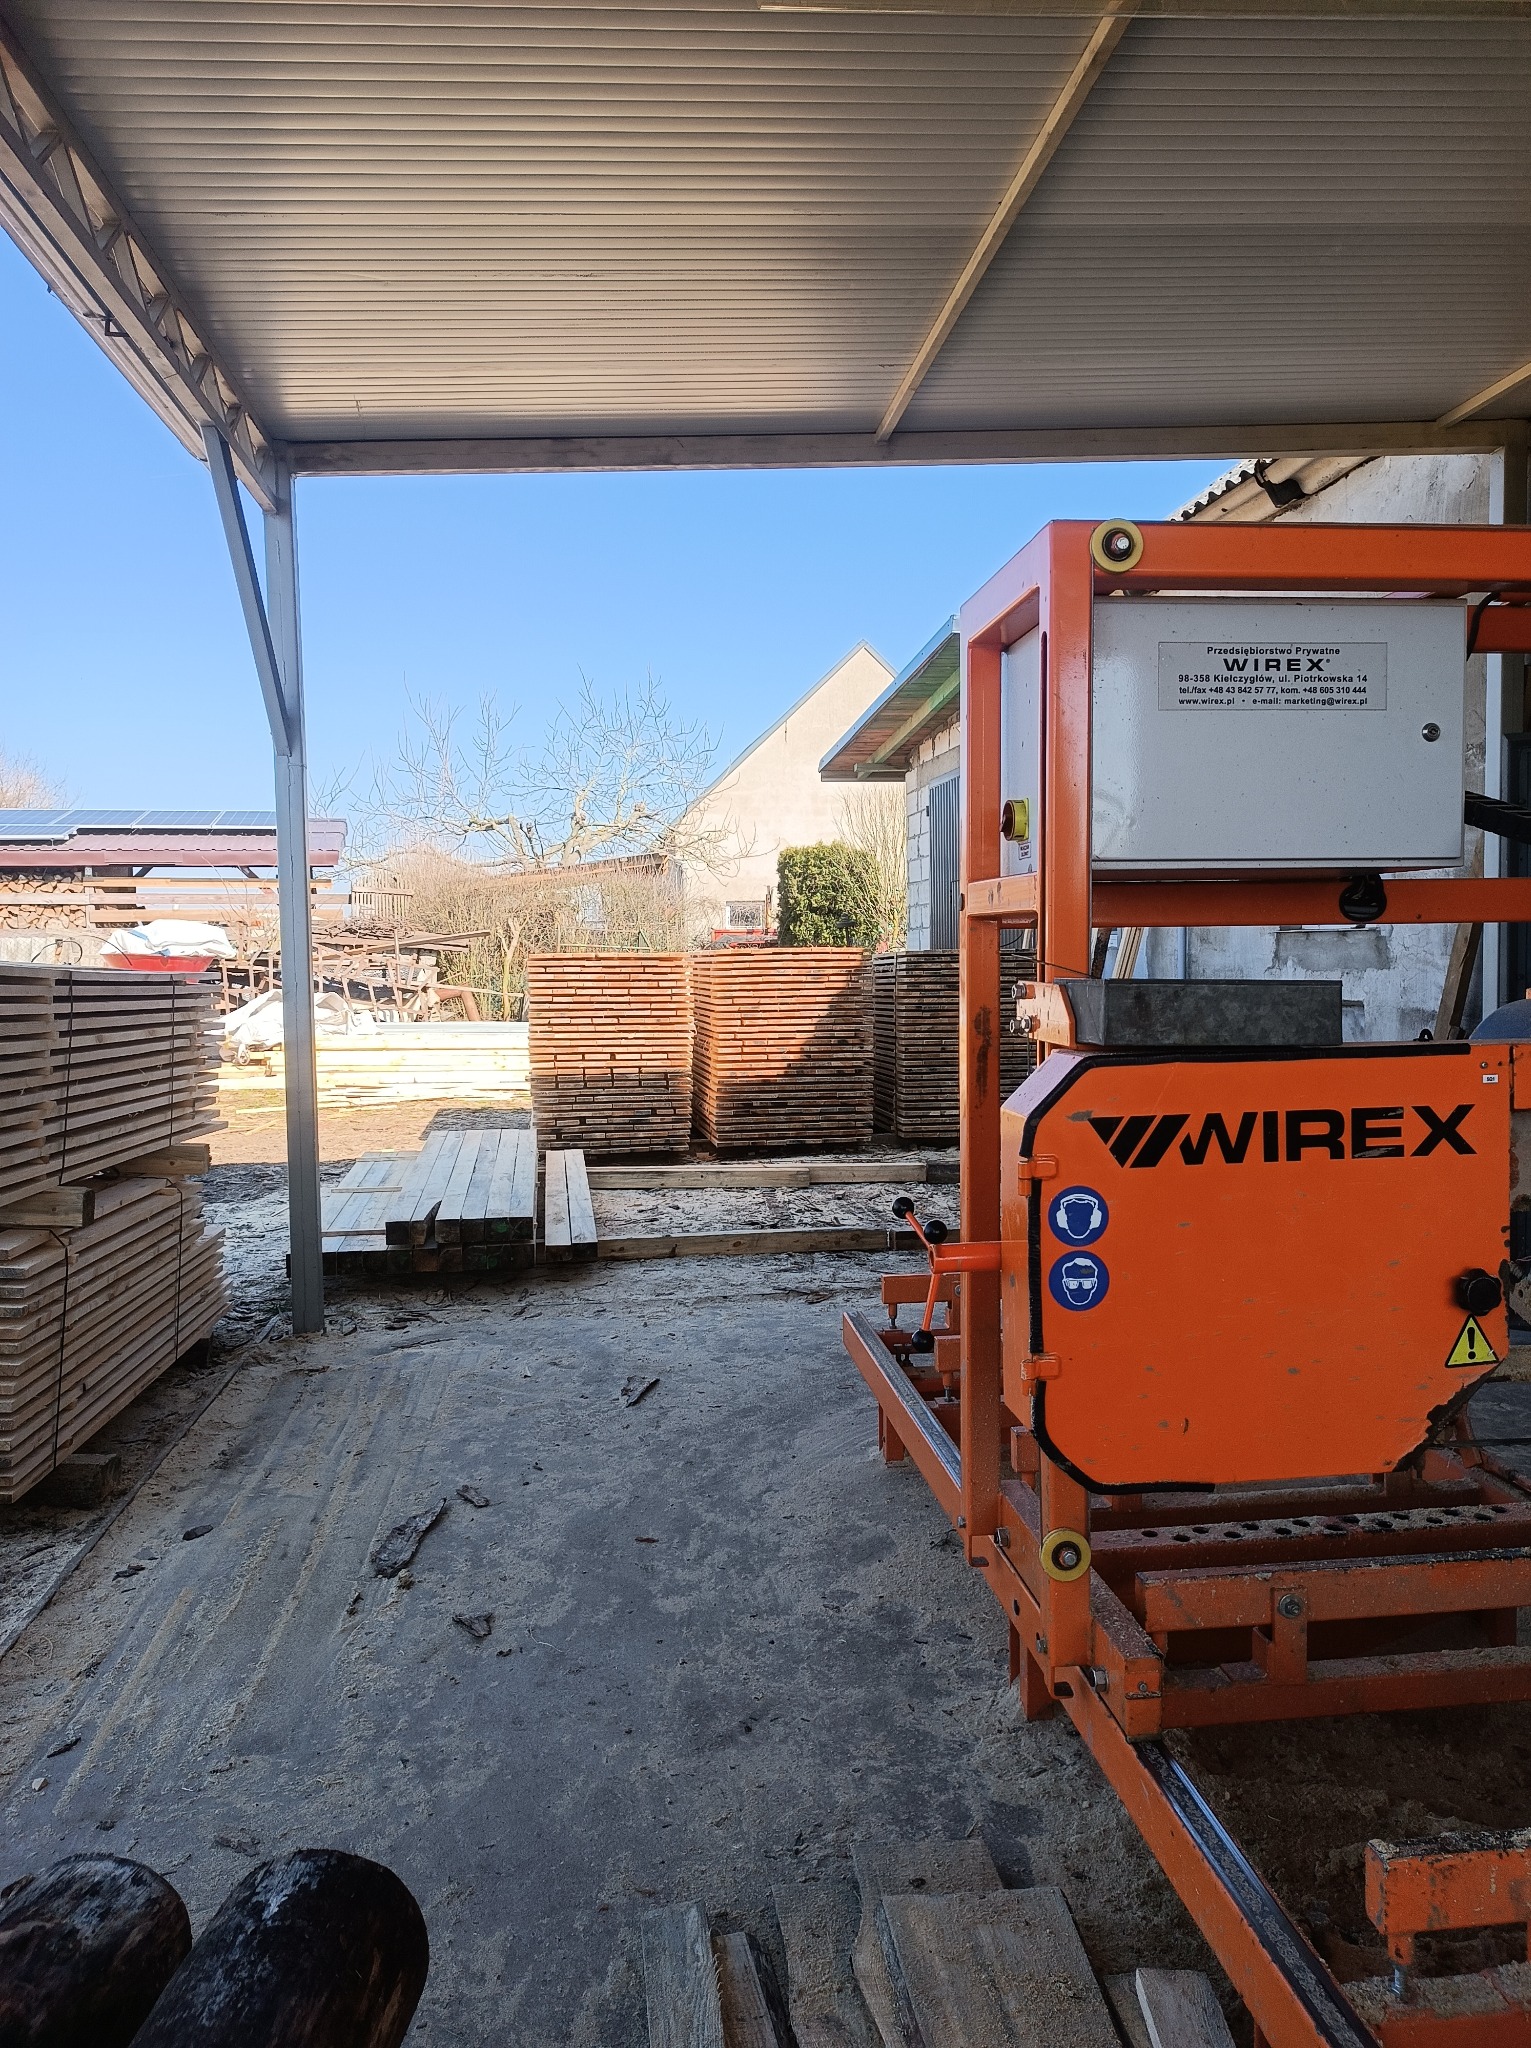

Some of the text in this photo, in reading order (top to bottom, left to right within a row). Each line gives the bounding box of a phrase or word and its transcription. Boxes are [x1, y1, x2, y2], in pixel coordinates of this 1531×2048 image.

[1207, 646, 1341, 657] Przedsiębiorstwo Prywatne
[1178, 674, 1211, 683] 98-358
[1278, 674, 1290, 683] ul.
[1294, 674, 1354, 683] Piotrkowska
[1356, 674, 1368, 683] 14
[1179, 686, 1367, 695] tel./fax +48 43 842 57 77, kom. +48 605 310 444
[1178, 698, 1235, 706] www.wirex.pl
[1284, 698, 1368, 706] marketing@wirex.pl
[1179, 1103, 1479, 1166] WIREX
